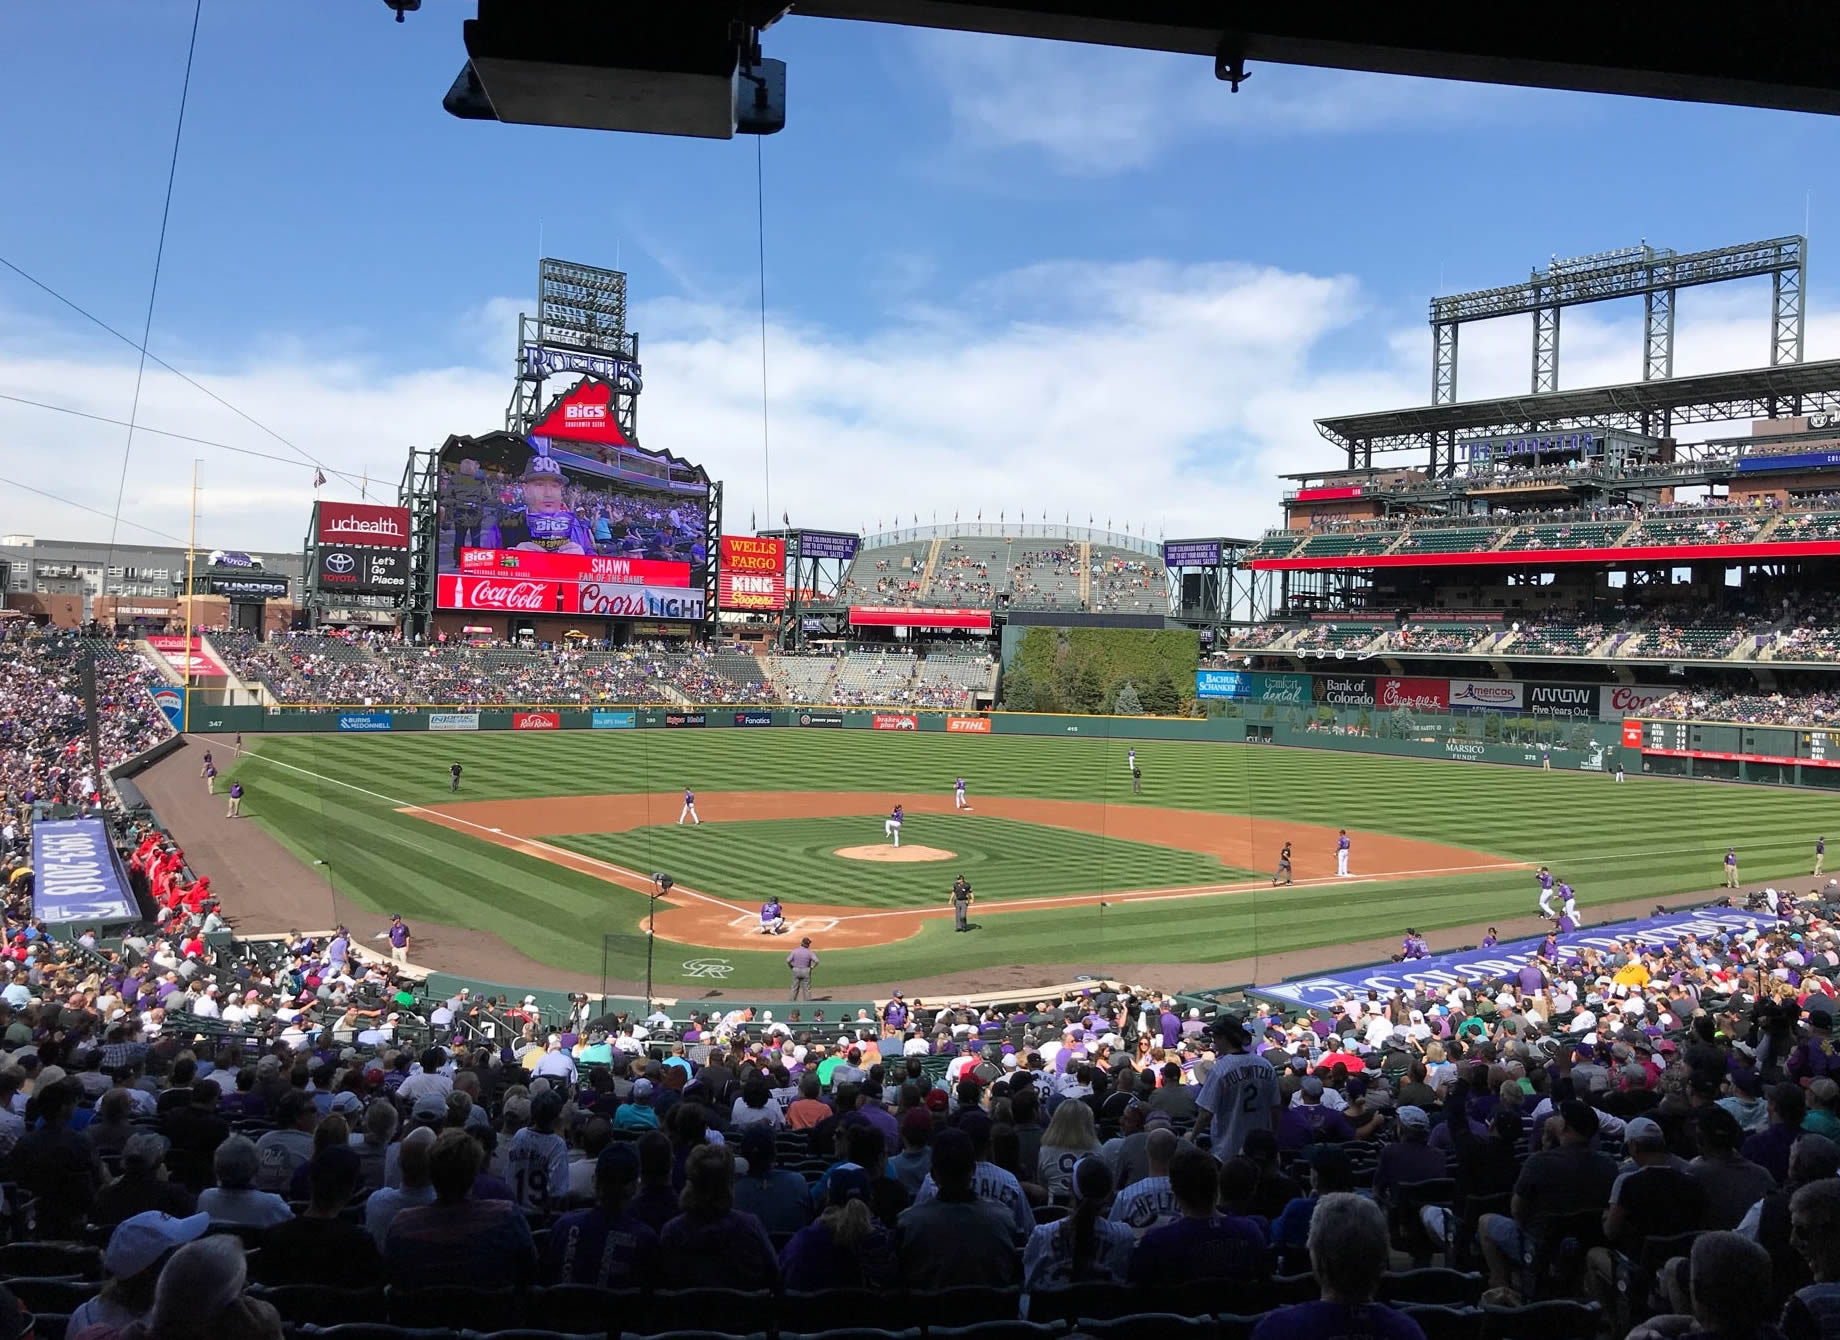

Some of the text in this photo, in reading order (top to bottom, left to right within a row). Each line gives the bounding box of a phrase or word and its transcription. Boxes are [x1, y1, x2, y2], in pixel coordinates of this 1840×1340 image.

[525, 346, 643, 394] ROCKIES
[331, 514, 398, 535] uchealth
[730, 540, 777, 554] WELLS
[223, 556, 252, 568] TOYOTA
[371, 555, 395, 565] Let's
[592, 558, 630, 575] SHAWN
[730, 556, 776, 570] FARGO
[372, 566, 386, 576] Go
[322, 574, 357, 583] TOYOTA
[371, 576, 405, 586] Places
[579, 573, 645, 585] FAN OF THE GAME
[732, 576, 774, 592] KING
[213, 581, 285, 593] TUNDRA
[580, 583, 703, 618] Coors LIGHT
[732, 592, 774, 608] Soopers
[1234, 675, 1243, 684] &
[1265, 676, 1298, 689] Comfort
[1326, 679, 1366, 692] Bank of
[1262, 686, 1302, 702] dental
[1326, 691, 1374, 705] Colorado
[1532, 705, 1588, 716] Five Years Out
[520, 718, 552, 728] Red Robin
[951, 720, 986, 730] STIHL
[1446, 744, 1484, 754] MARSICO
[42, 832, 106, 896] 1993-2018
[1244, 1083, 1258, 1113] 2
[516, 1169, 548, 1204] 19
